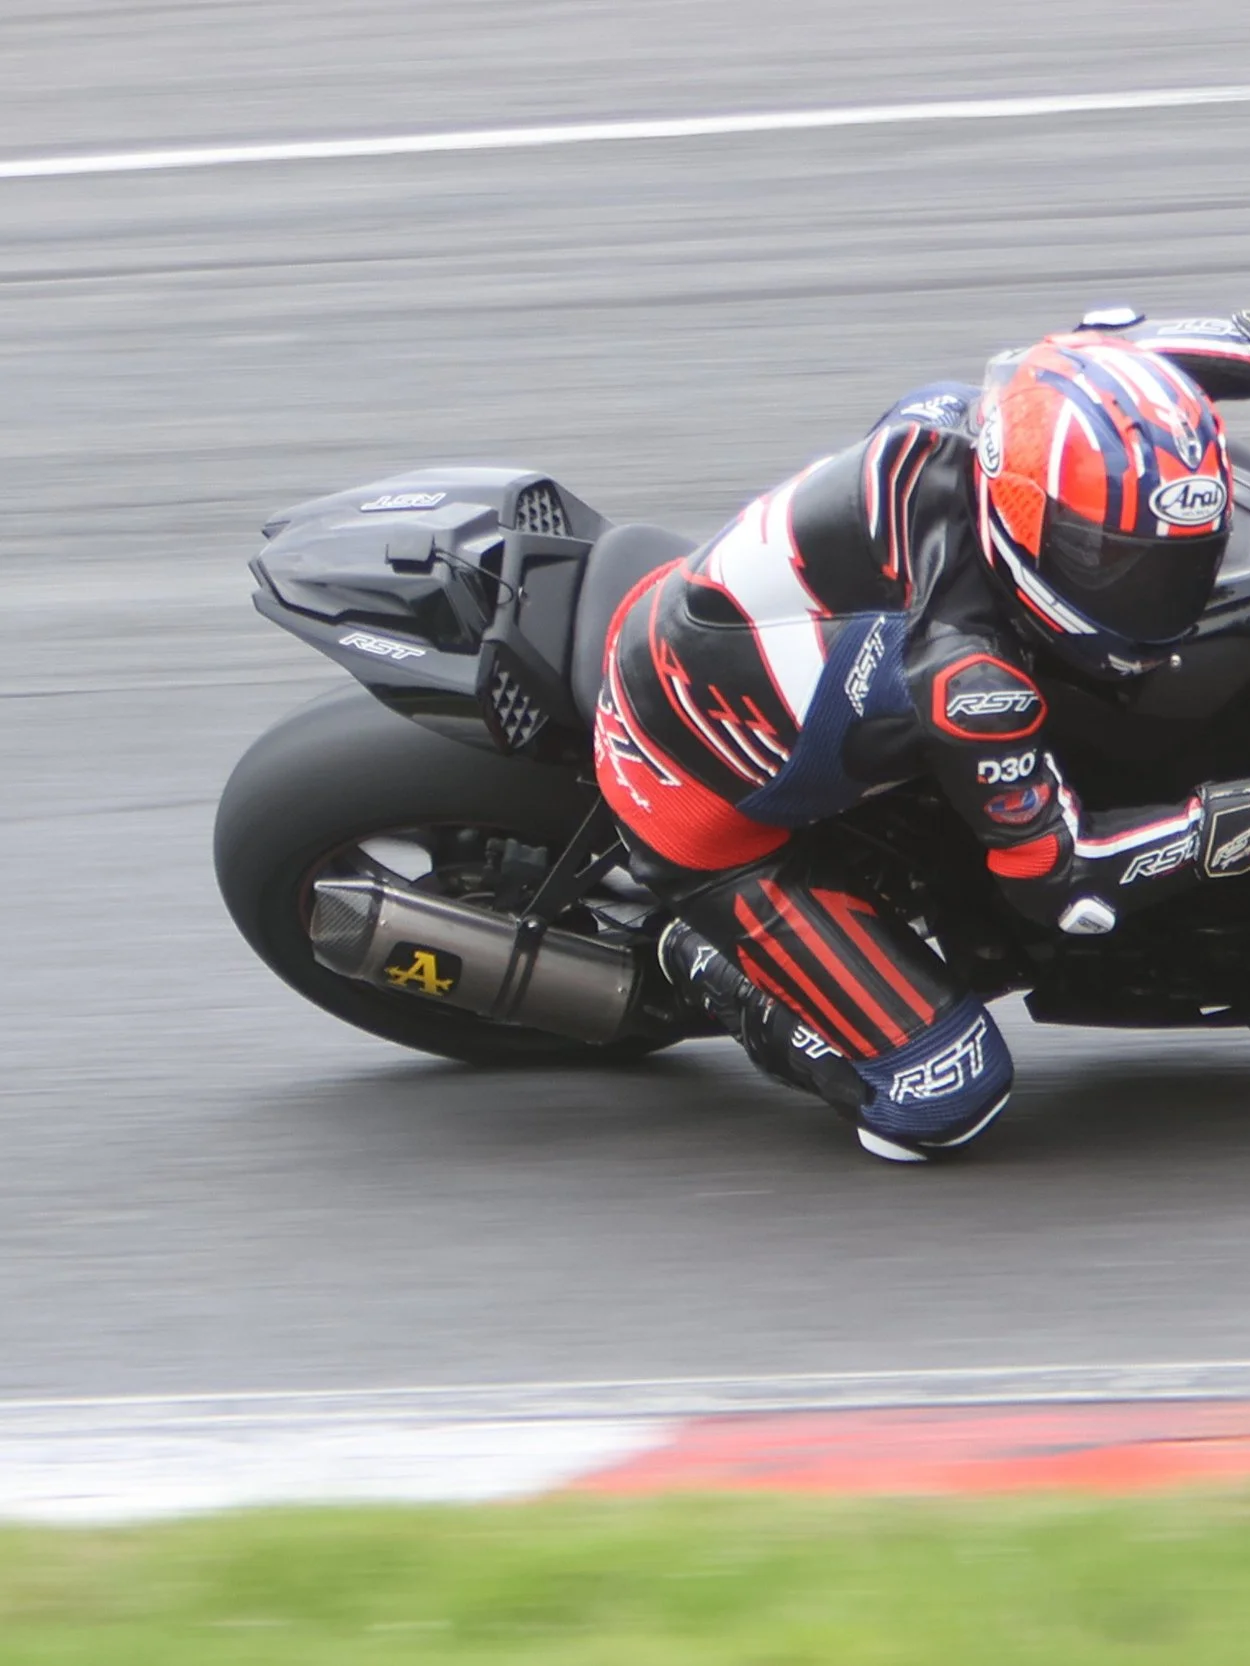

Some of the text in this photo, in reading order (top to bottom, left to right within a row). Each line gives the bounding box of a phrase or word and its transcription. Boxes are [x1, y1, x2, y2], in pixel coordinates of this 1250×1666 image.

[1161, 483, 1219, 509] Arai
[339, 632, 426, 660] RST
[844, 615, 886, 718] RST
[947, 690, 1039, 718] RST
[889, 1014, 988, 1105] RST
